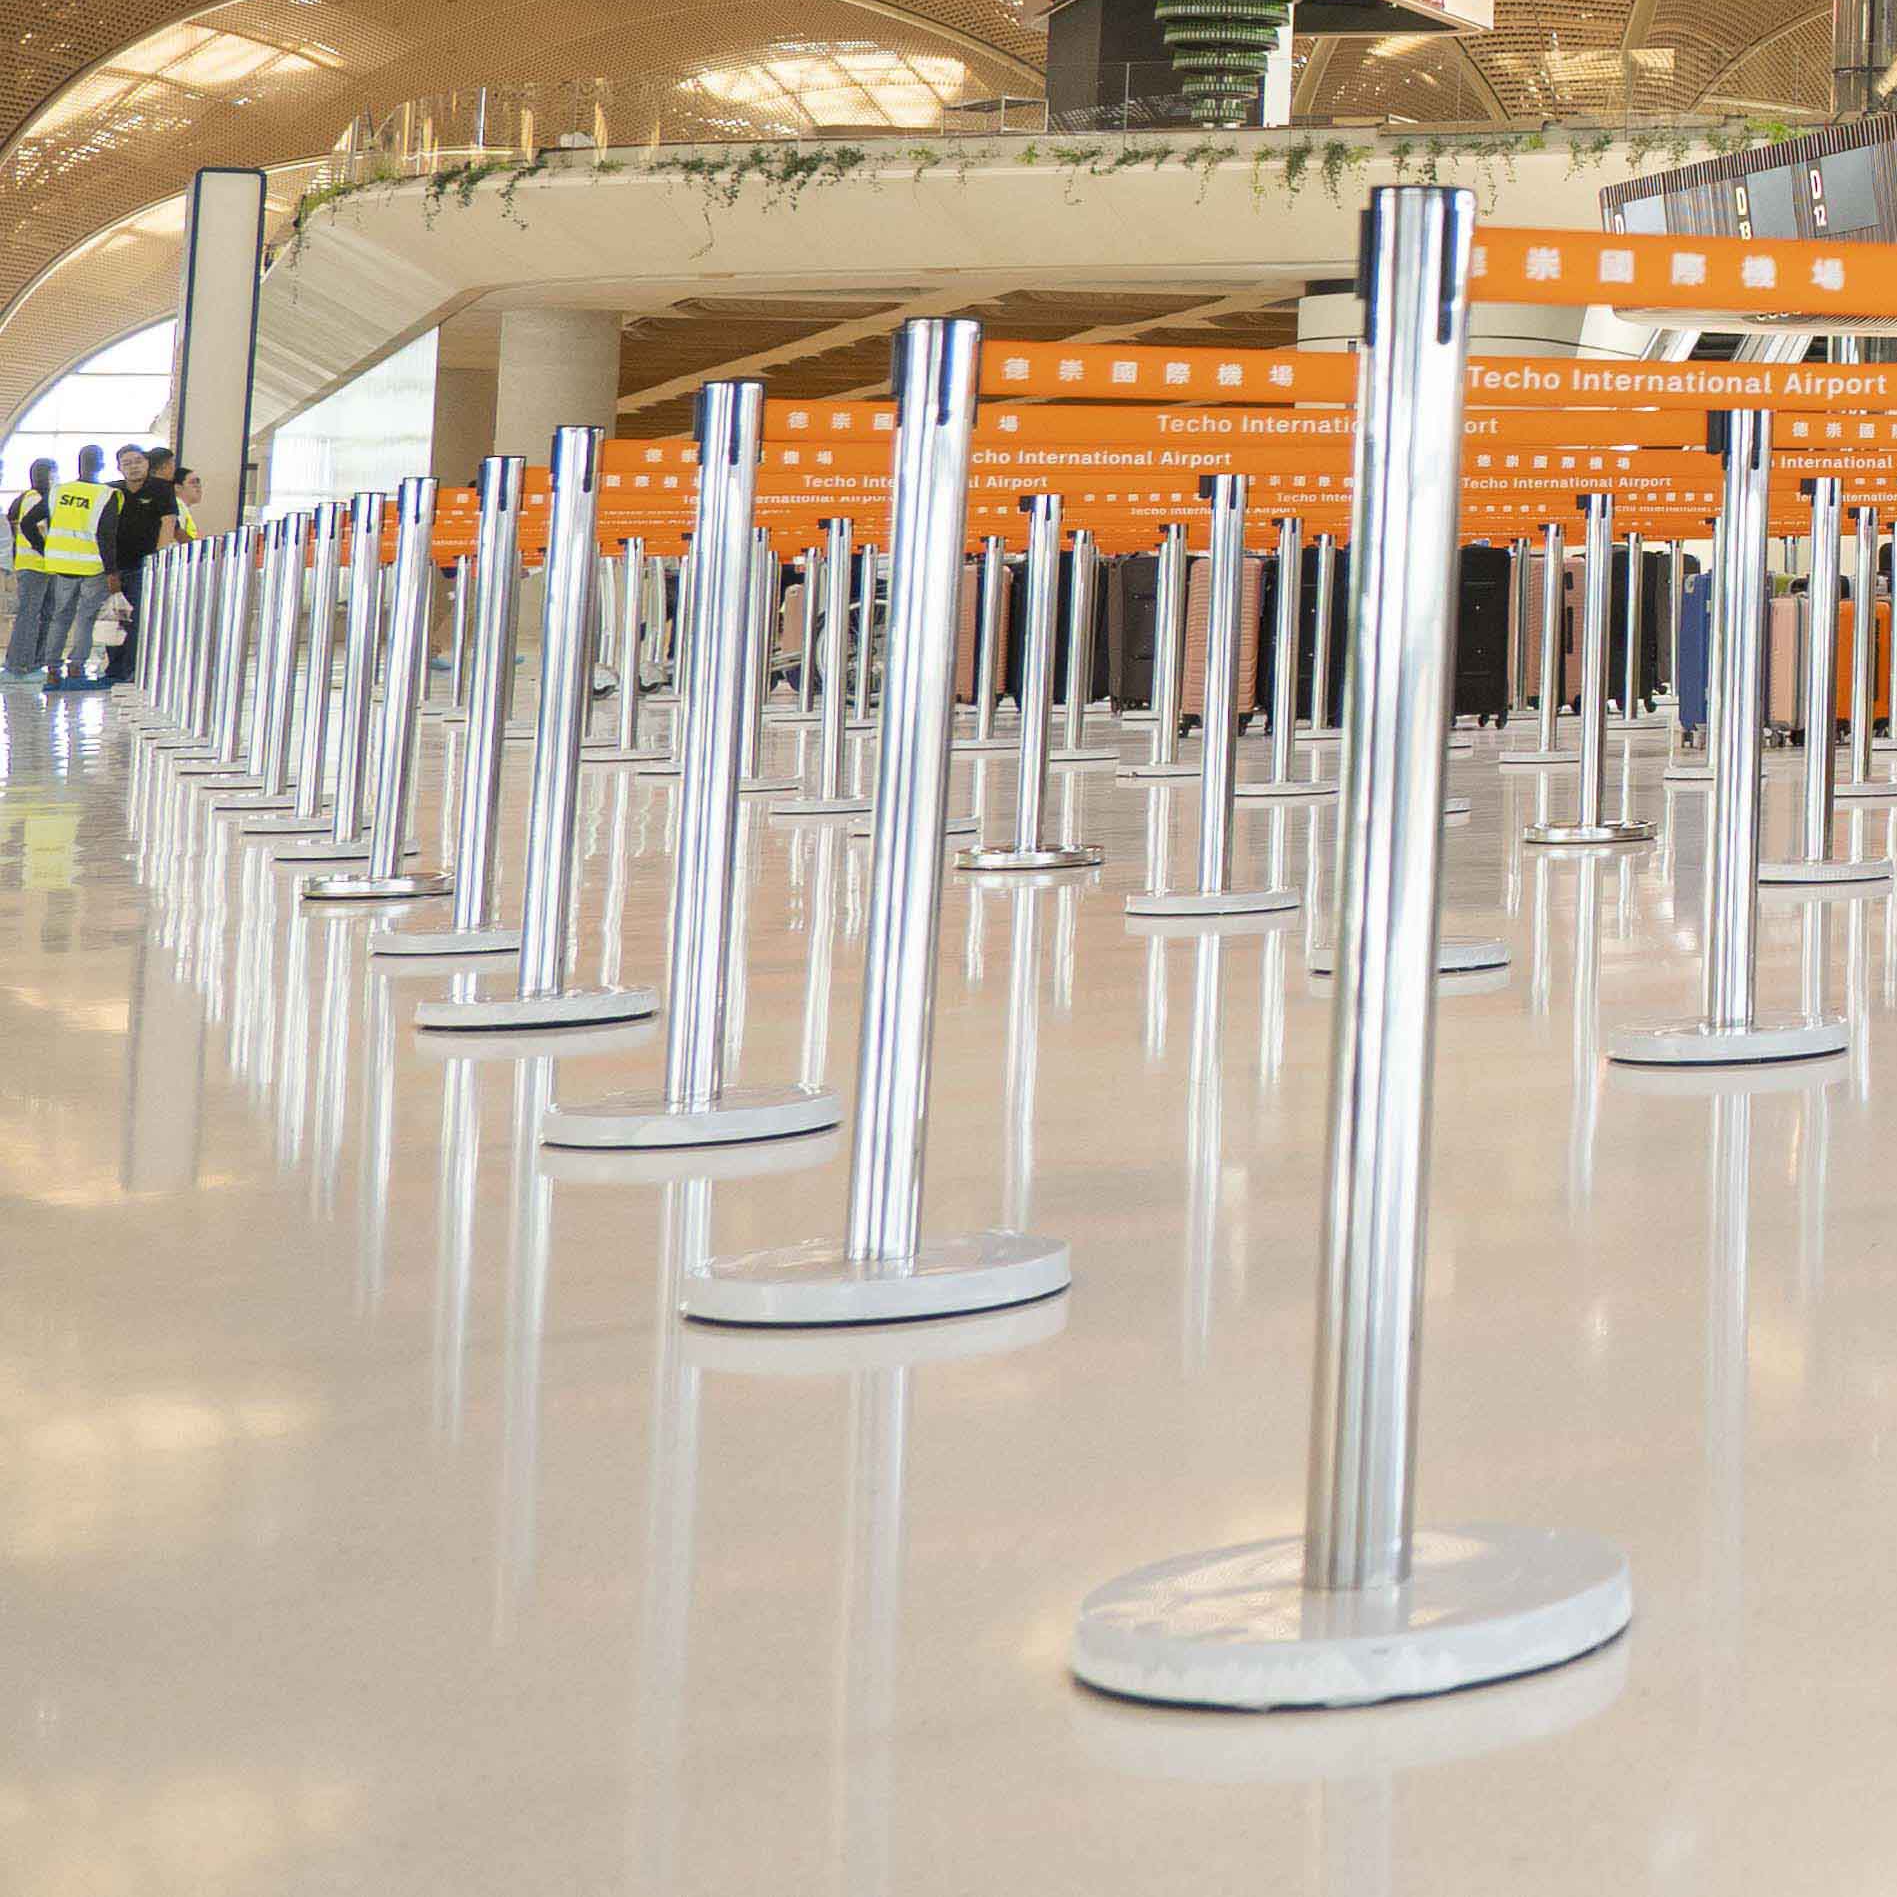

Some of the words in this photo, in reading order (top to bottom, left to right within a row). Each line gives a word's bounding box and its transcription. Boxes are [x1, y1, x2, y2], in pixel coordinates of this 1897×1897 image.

[1809, 169, 1823, 199] D
[1735, 186, 1747, 216] D
[1813, 205, 1827, 227] 12
[1738, 220, 1751, 240] 13
[1003, 358, 1294, 386] 德崇國際機場
[1467, 366, 1560, 390] Techo
[1572, 369, 1771, 394] International
[1784, 373, 1887, 399] Airport
[789, 412, 1017, 431] 德崇國場
[1157, 414, 1232, 432] Techo
[1242, 415, 1360, 434] Internatio
[972, 450, 1008, 464] cho
[1016, 450, 1152, 465] International
[1160, 451, 1232, 468] Airport
[1781, 455, 1892, 469] International
[804, 475, 856, 487] Techo
[986, 476, 1047, 490] Airport
[1461, 477, 1508, 488] Techo
[1514, 477, 1612, 488] International
[1619, 477, 1672, 489] Airport
[59, 494, 90, 510] SITA
